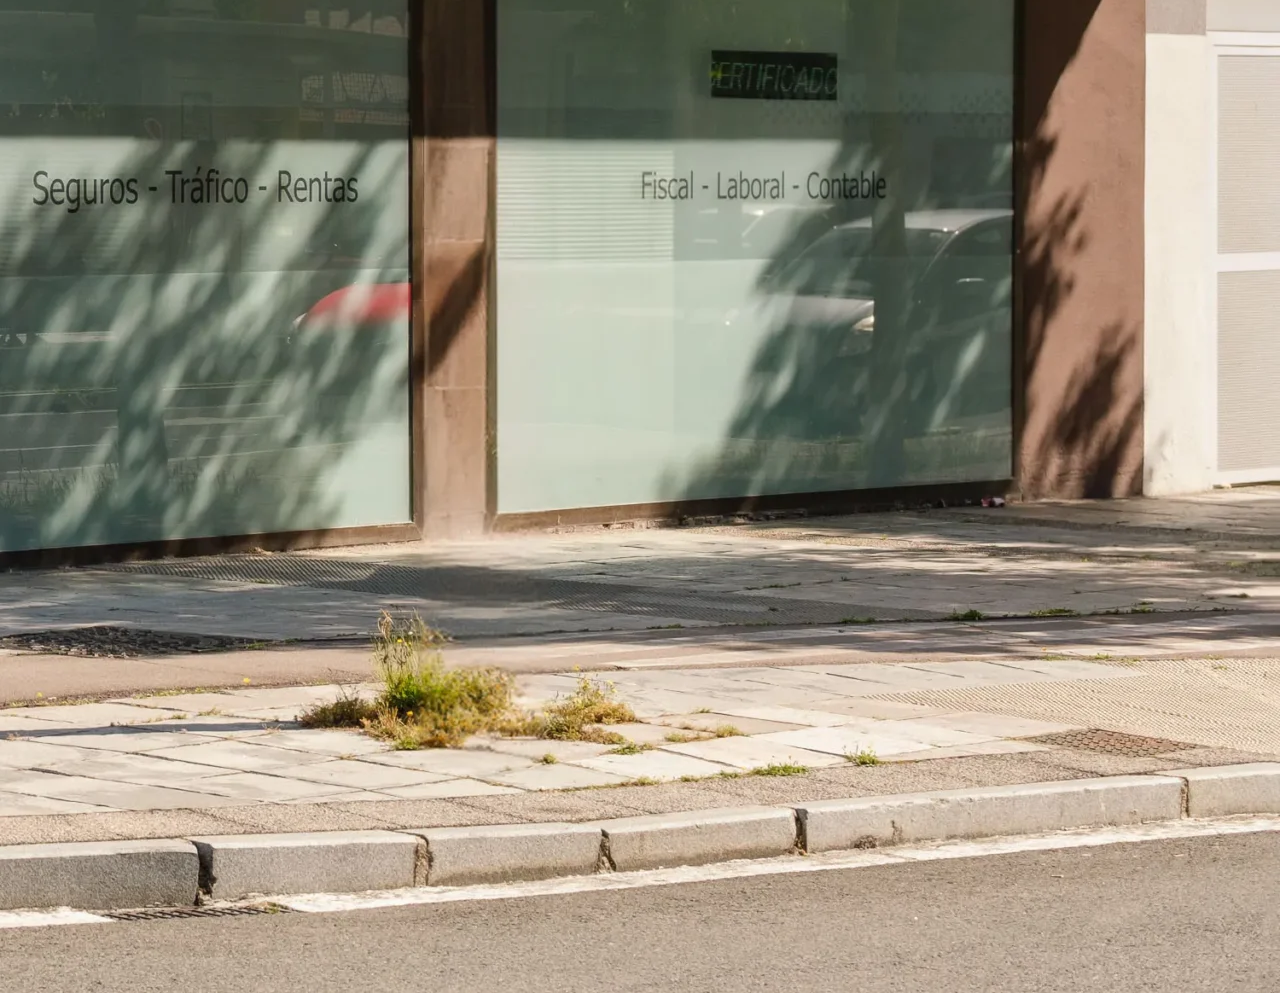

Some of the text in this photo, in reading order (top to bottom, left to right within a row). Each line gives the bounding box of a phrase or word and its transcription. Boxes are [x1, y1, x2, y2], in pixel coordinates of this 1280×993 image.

[33, 170, 139, 213] Seguros
[165, 166, 249, 203] Tráfico
[277, 170, 358, 203] Rentas
[641, 171, 693, 200] Fiscal
[718, 171, 785, 199] Laboral
[806, 171, 887, 200] Contable
